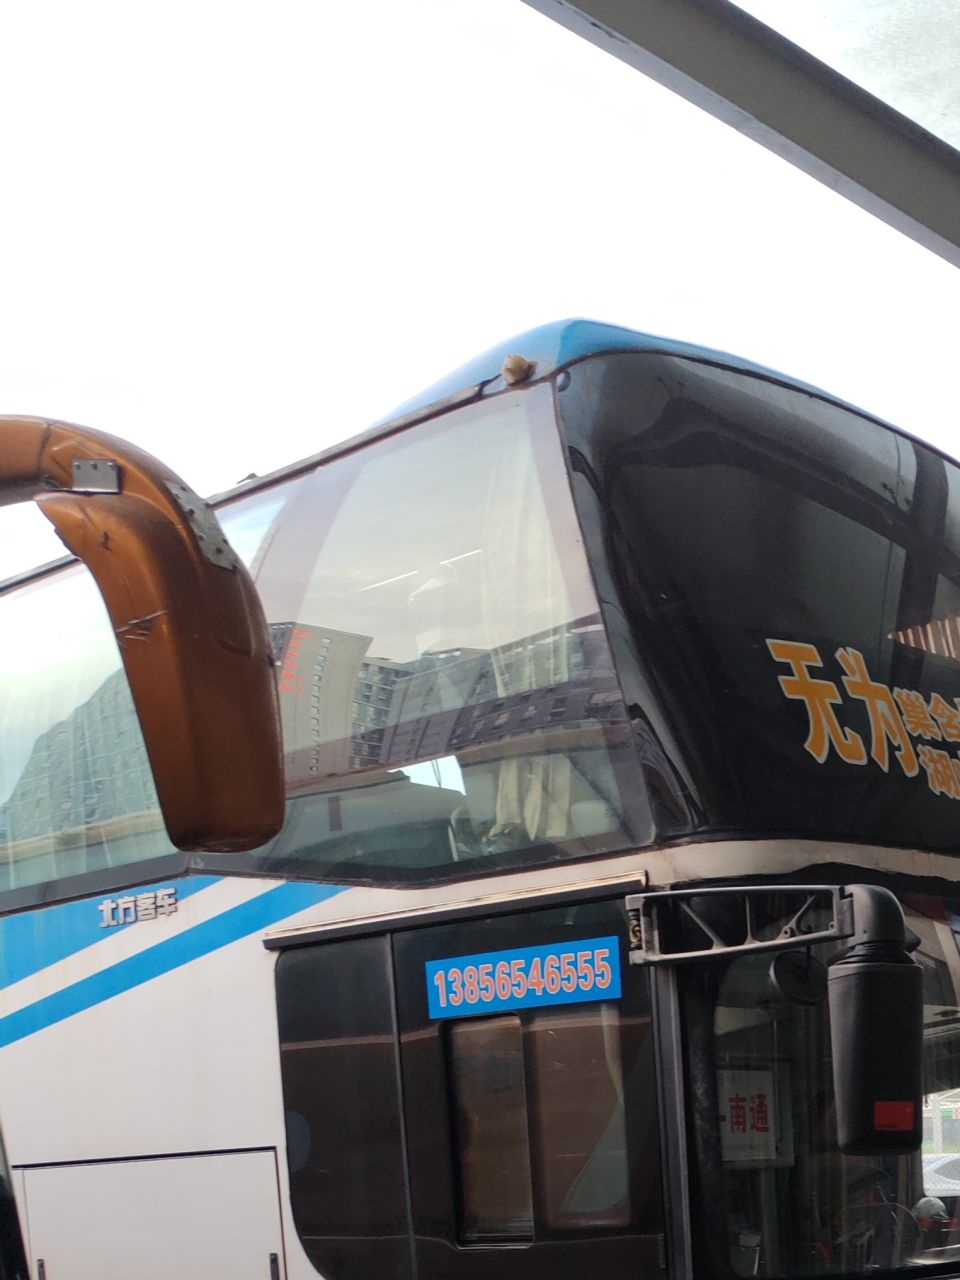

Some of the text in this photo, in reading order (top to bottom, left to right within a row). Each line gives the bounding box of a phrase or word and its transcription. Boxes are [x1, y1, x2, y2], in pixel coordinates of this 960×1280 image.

[765, 638, 919, 778] 无为
[98, 888, 177, 928] 北方客车
[434, 949, 611, 1008] 13856546555
[728, 1093, 769, 1133] 南通
